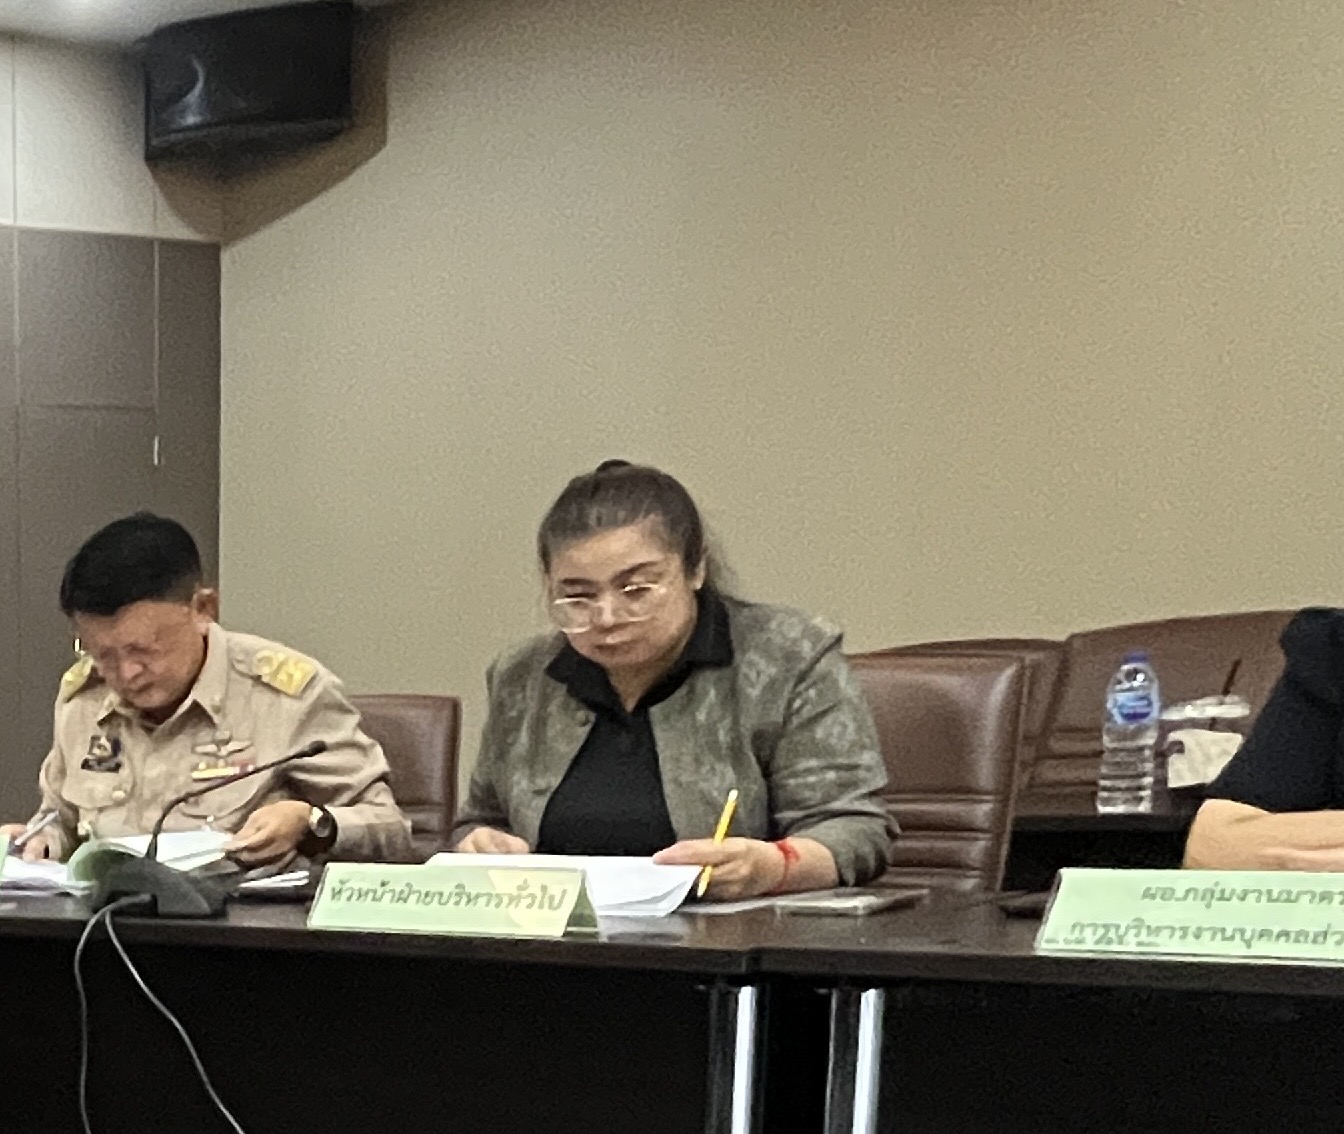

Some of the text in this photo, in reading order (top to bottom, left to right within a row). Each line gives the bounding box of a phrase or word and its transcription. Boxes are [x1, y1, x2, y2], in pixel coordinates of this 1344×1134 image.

[330, 878, 568, 912] หัวหน้าฝ่ายบริหารทั่วไป
